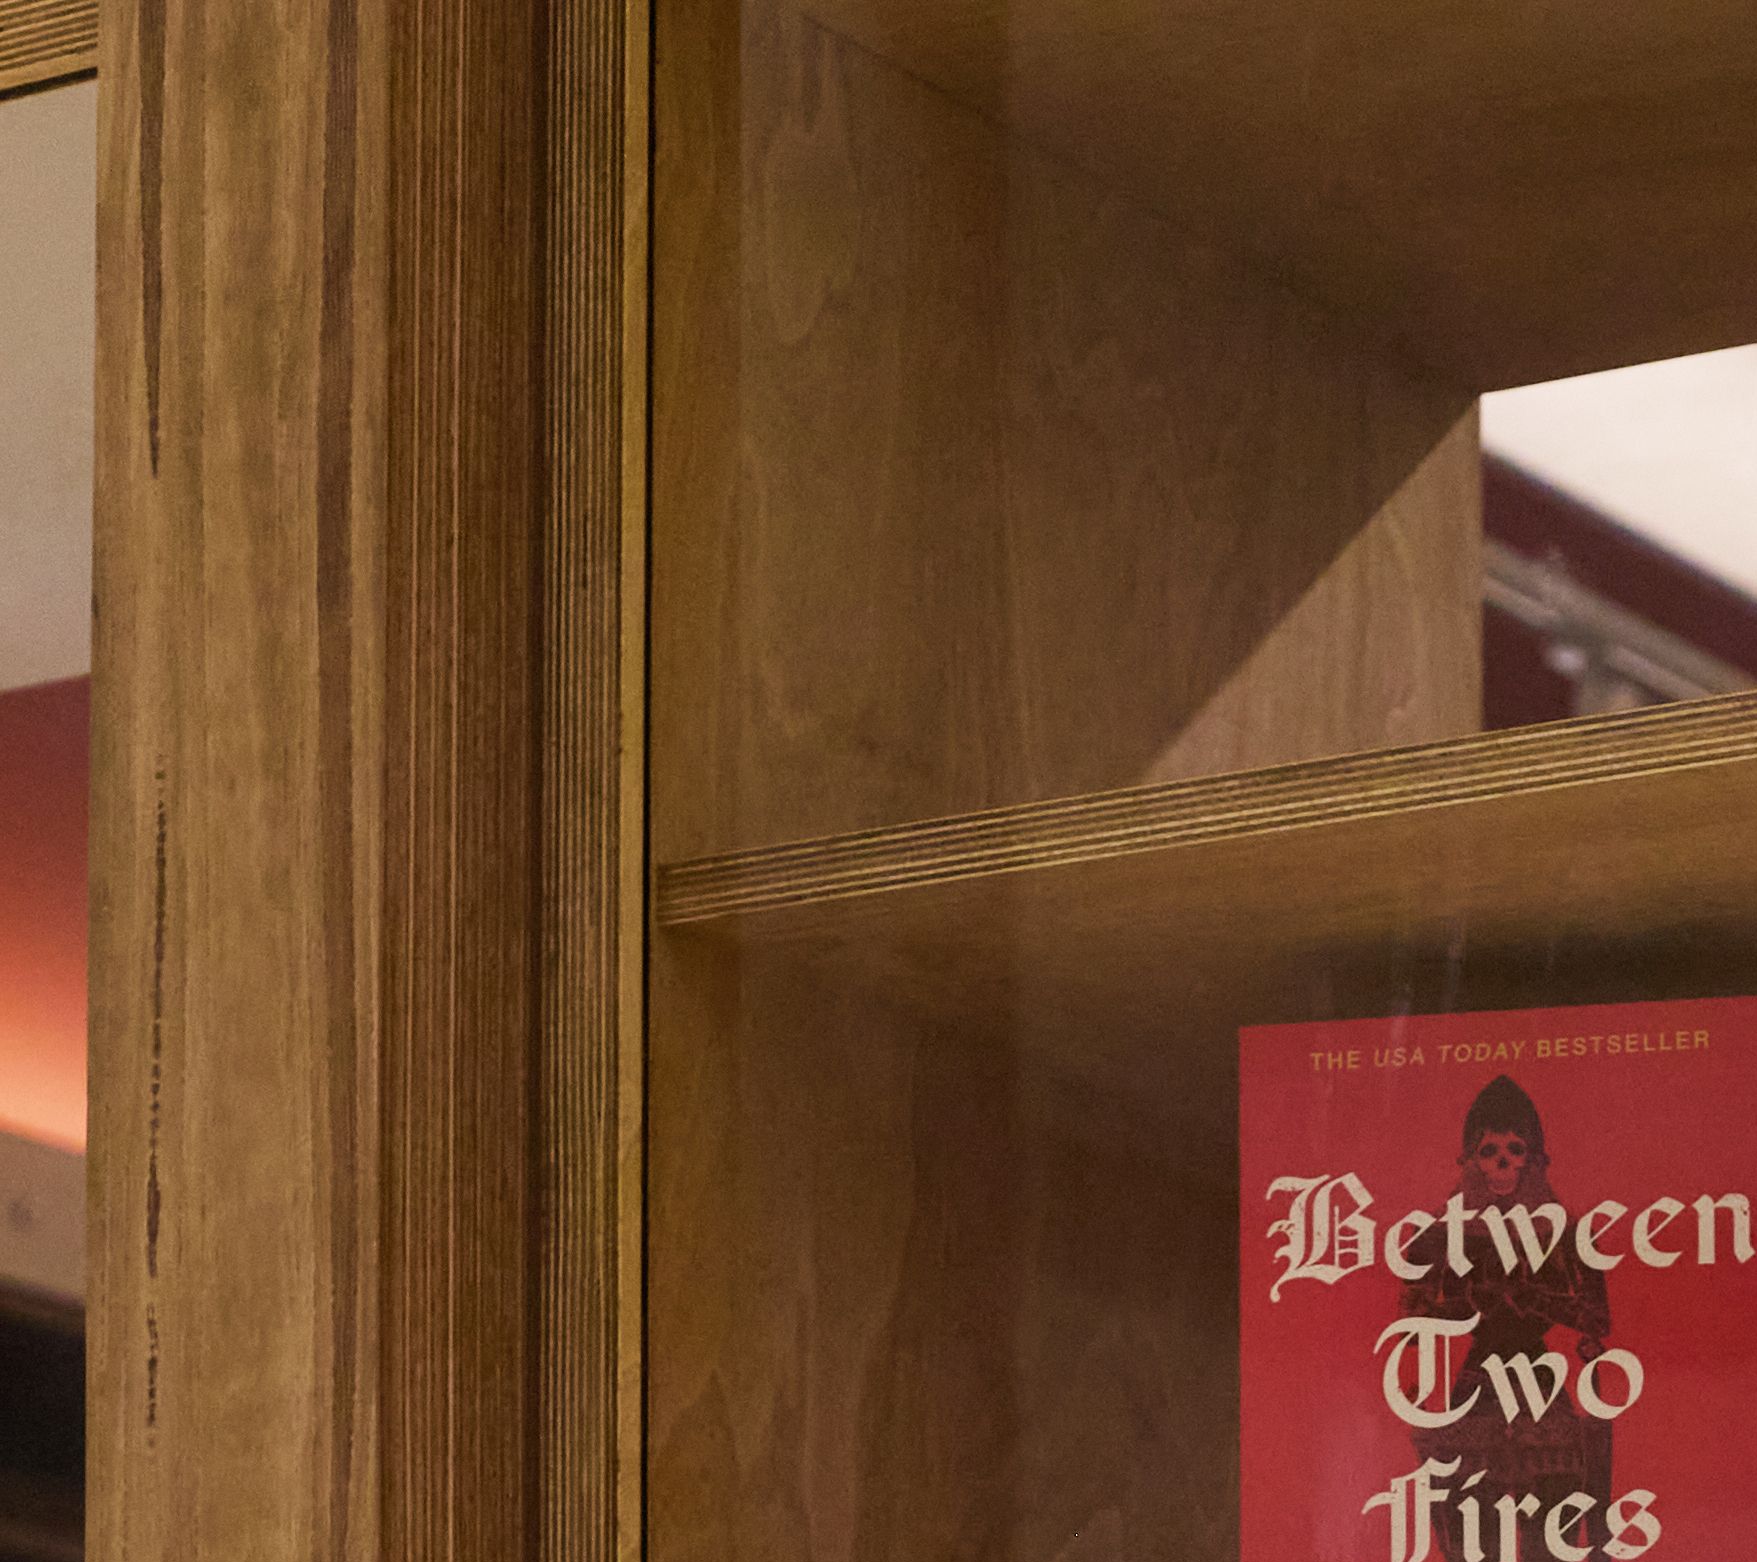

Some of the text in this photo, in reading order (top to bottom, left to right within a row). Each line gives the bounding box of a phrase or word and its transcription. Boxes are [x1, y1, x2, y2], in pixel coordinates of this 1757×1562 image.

[1310, 1030, 1710, 1071] THE USA TODAY BESTSELLER
[1266, 1172, 1756, 1302] Between
[1374, 1311, 1644, 1428] Two
